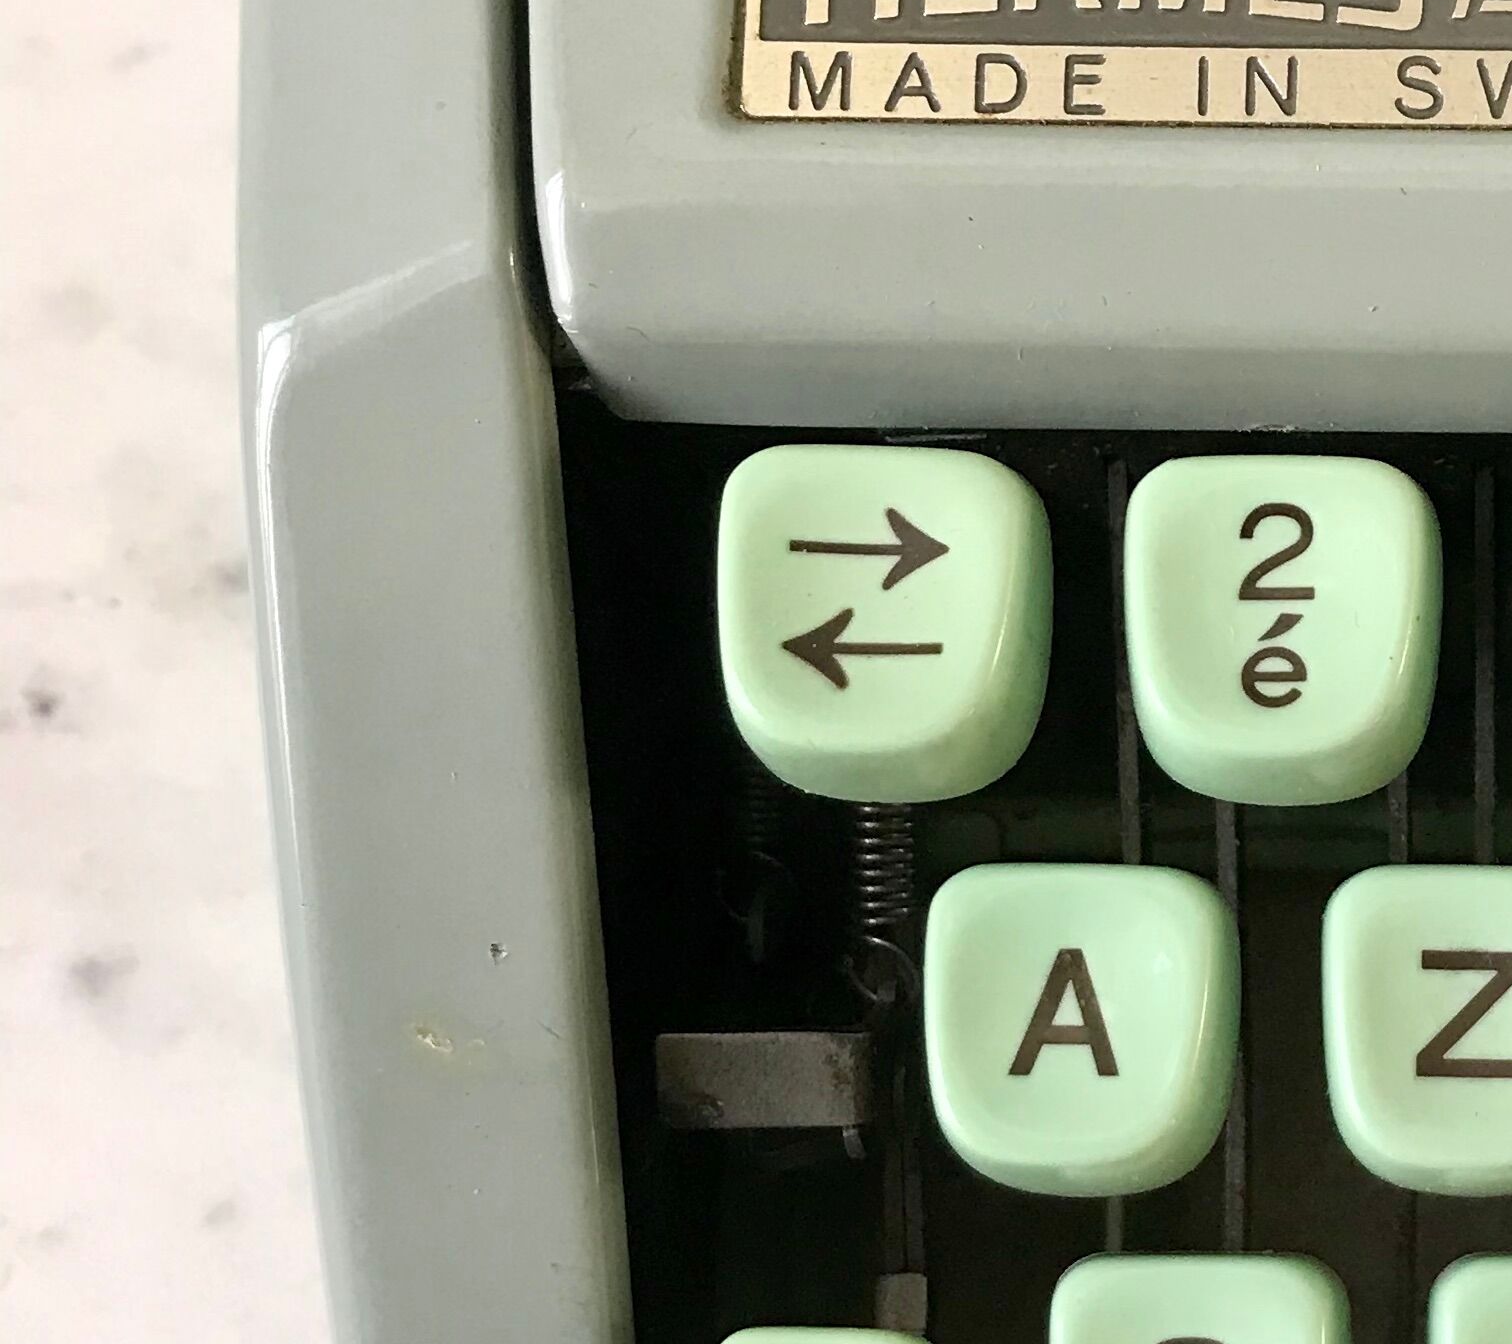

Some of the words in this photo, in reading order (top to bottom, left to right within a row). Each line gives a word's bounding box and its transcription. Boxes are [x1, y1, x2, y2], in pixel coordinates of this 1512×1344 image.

[788, 50, 1108, 116] MADE
[1196, 55, 1300, 117] IN
[1239, 503, 1314, 600] 2
[1241, 612, 1307, 708] é
[1008, 949, 1118, 1076] A
